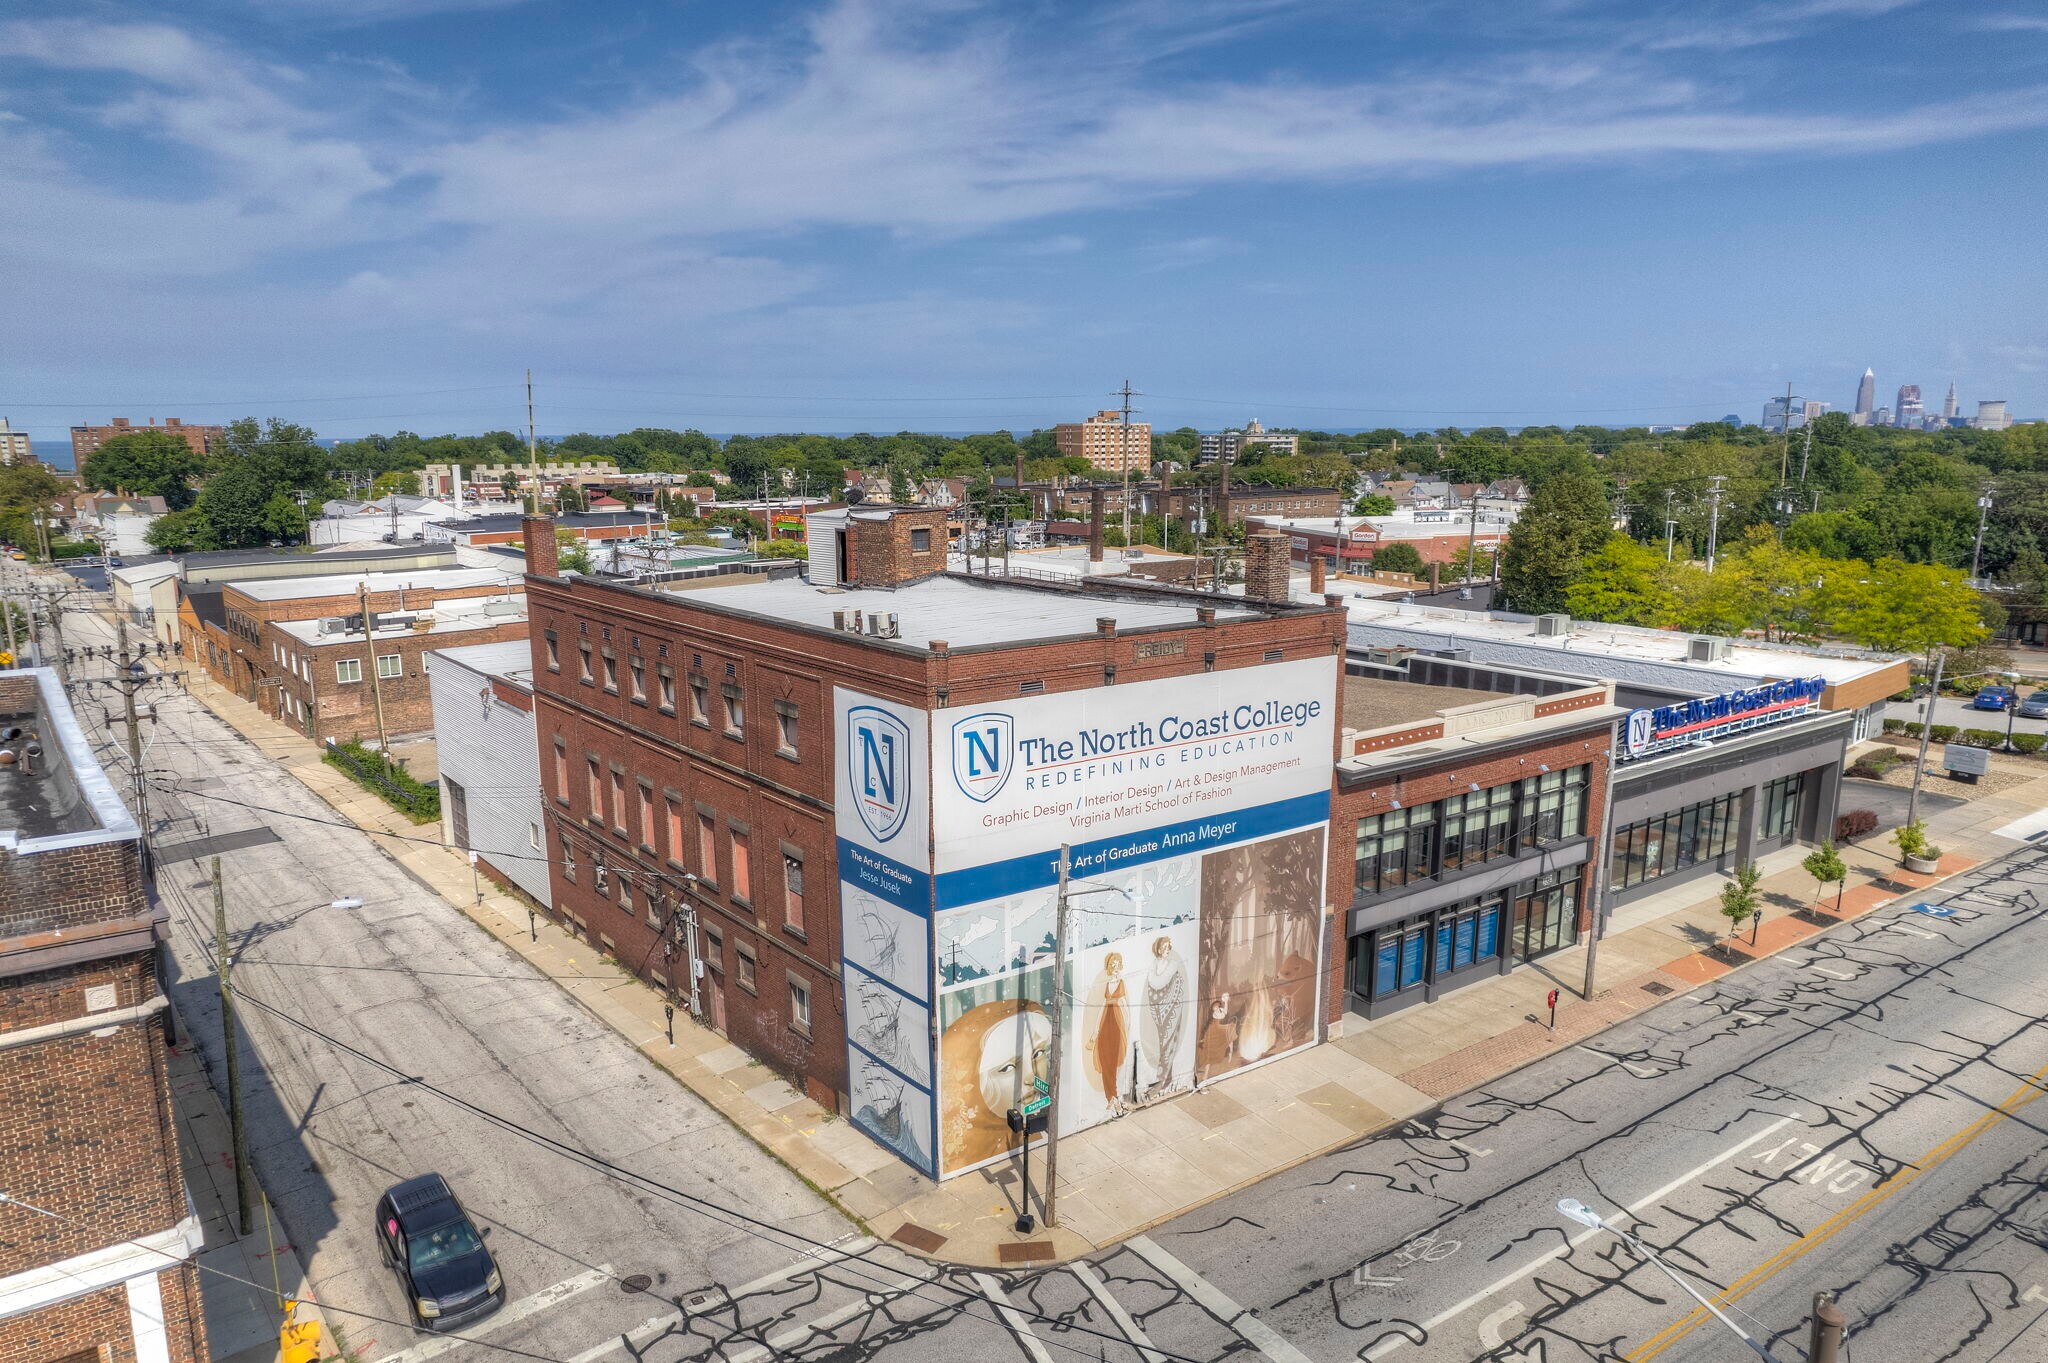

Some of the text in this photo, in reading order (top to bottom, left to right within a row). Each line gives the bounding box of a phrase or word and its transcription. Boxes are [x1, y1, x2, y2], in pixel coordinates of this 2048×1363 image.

[1144, 641, 1176, 657] REIDY
[1653, 705, 1687, 731] The
[1688, 693, 1730, 720] North
[1731, 686, 1773, 710] Coast
[1773, 677, 1827, 702] College
[963, 727, 999, 777] N
[1019, 700, 1321, 766] The North Coast College
[1633, 717, 1647, 742] N
[858, 726, 895, 805] N
[1026, 731, 1293, 790] REDEFINING EDUCATION
[982, 808, 1029, 828] Graphic
[1033, 801, 1073, 818] Design
[1085, 791, 1125, 807] Interior
[1127, 781, 1164, 799] Design
[1174, 776, 1190, 790] Art
[1193, 774, 1202, 786] &
[1204, 768, 1238, 785] Design
[1240, 757, 1301, 777] Management
[1070, 785, 1233, 828] Virginia Marti School of Fashion
[851, 849, 912, 884] The Art of Graduate
[1075, 855, 1093, 869] Art
[1095, 849, 1107, 864] of
[1108, 841, 1158, 860] Graduate
[1162, 832, 1195, 849] Anna
[1198, 820, 1237, 841] Meyer
[859, 867, 901, 896] Jesse Jusek
[1752, 1137, 1870, 1194] ONLY
